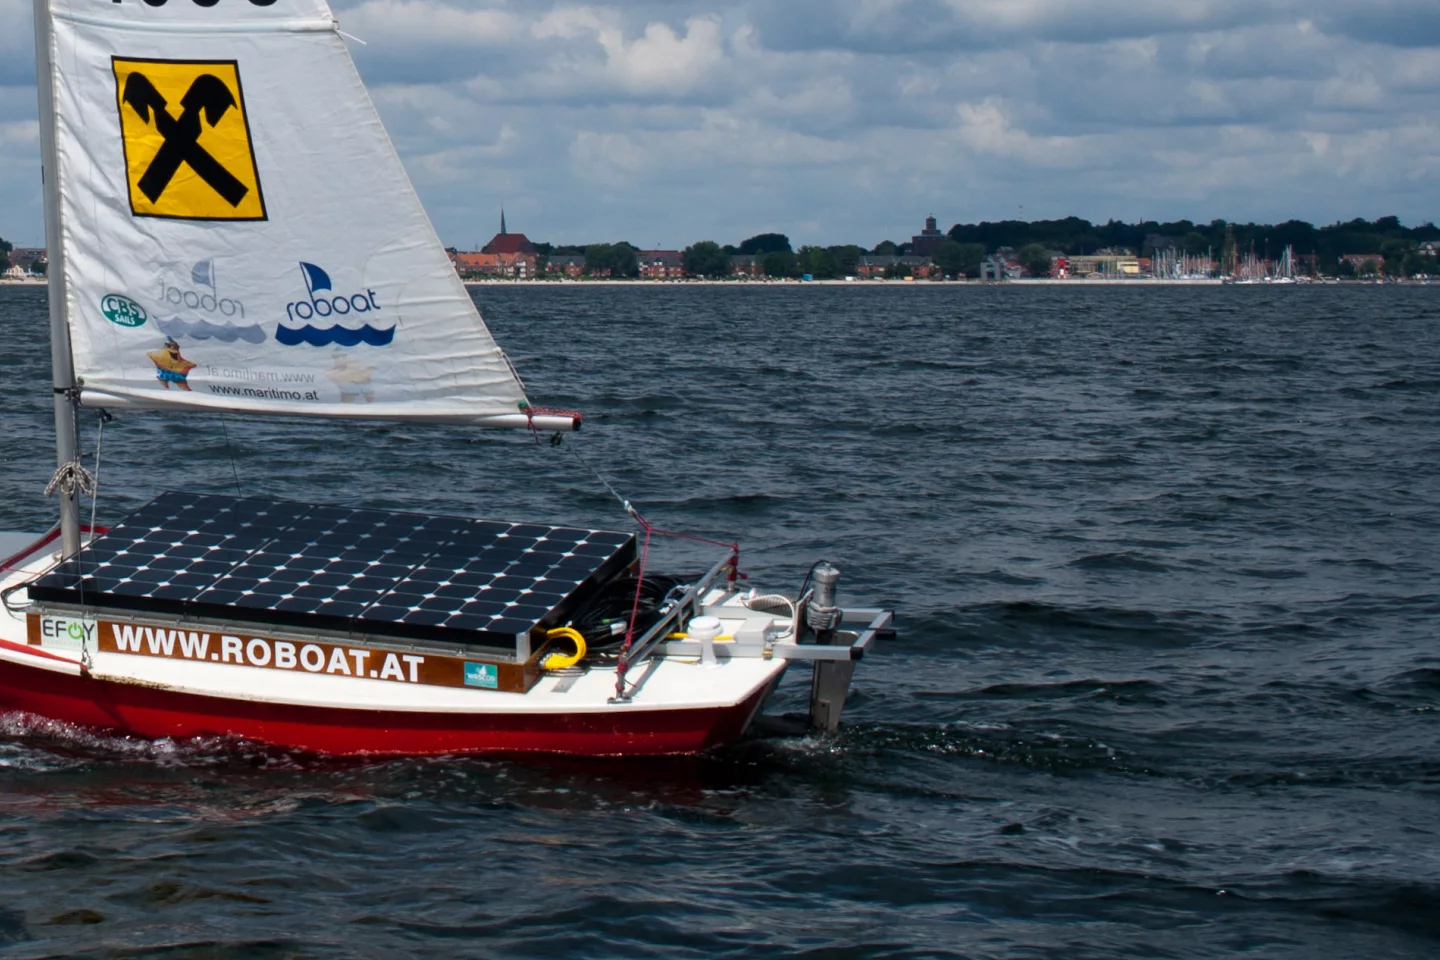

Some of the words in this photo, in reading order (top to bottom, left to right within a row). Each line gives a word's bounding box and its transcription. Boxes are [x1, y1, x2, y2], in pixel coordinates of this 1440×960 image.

[107, 297, 140, 319] CBS
[286, 280, 381, 323] roboat
[114, 314, 135, 326] SAILS
[209, 384, 319, 401] www.maritimo.at
[112, 624, 425, 683] WWW.ROBOAT.AT
